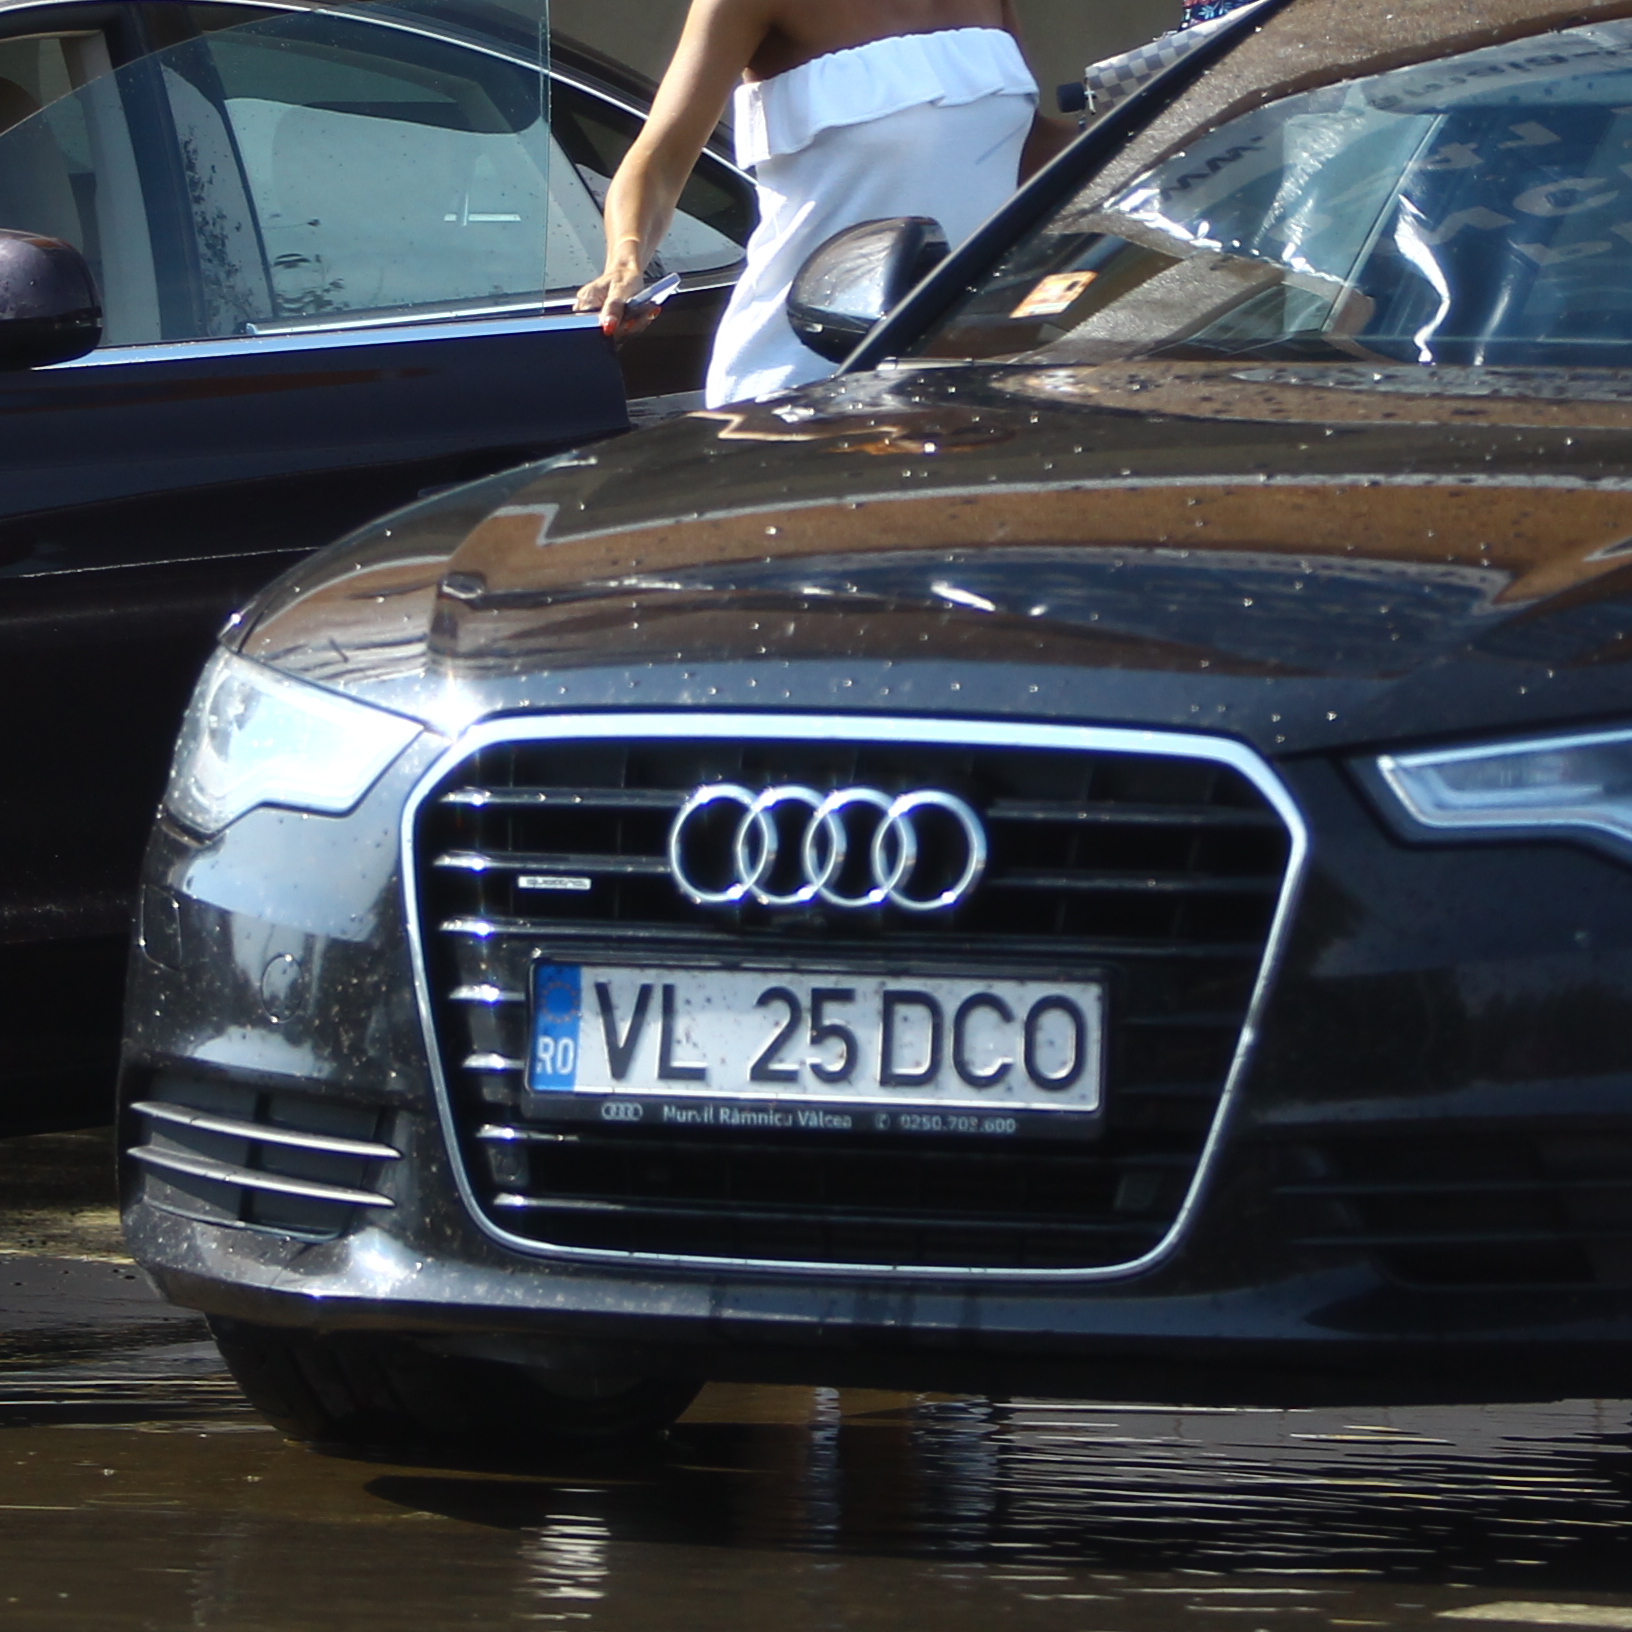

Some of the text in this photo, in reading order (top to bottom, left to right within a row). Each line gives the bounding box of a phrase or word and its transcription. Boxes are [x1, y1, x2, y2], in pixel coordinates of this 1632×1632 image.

[536, 1036, 575, 1076] RO
[595, 982, 1088, 1092] VL 25 DCO
